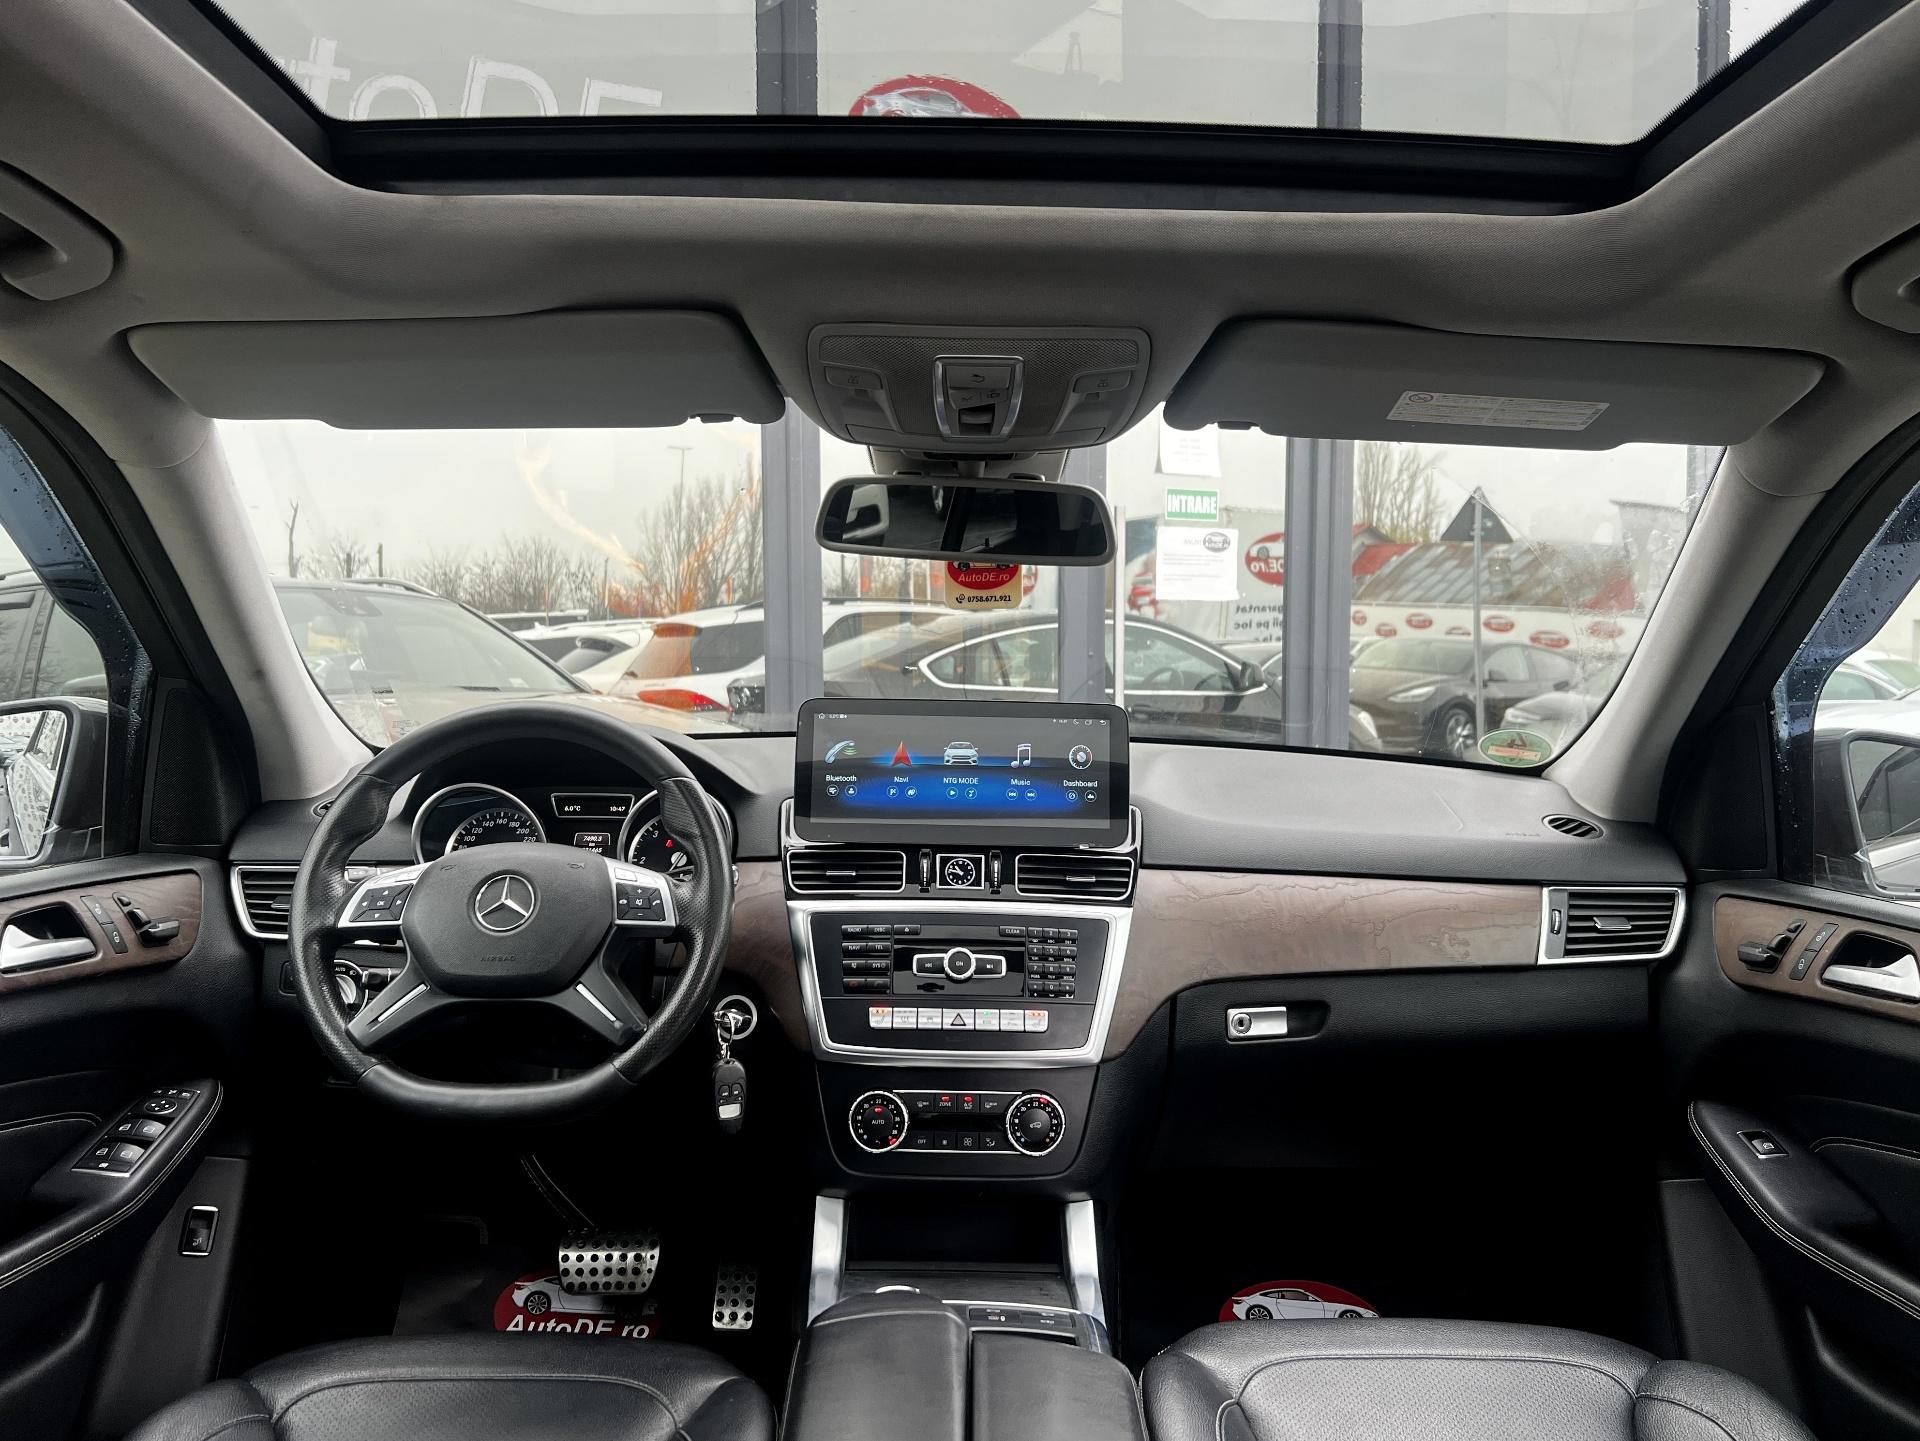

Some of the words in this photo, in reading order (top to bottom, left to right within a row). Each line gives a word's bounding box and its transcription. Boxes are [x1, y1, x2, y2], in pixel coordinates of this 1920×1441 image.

[1167, 494, 1218, 514] INTRARE
[959, 572, 1010, 582] AutoDE.ro
[967, 594, 1012, 603] 0758.671.921
[825, 774, 857, 782] Bluetooth
[1011, 778, 1031, 786] Music
[1063, 779, 1098, 788] Dashboard
[652, 830, 659, 838] 3
[639, 856, 646, 864] 2
